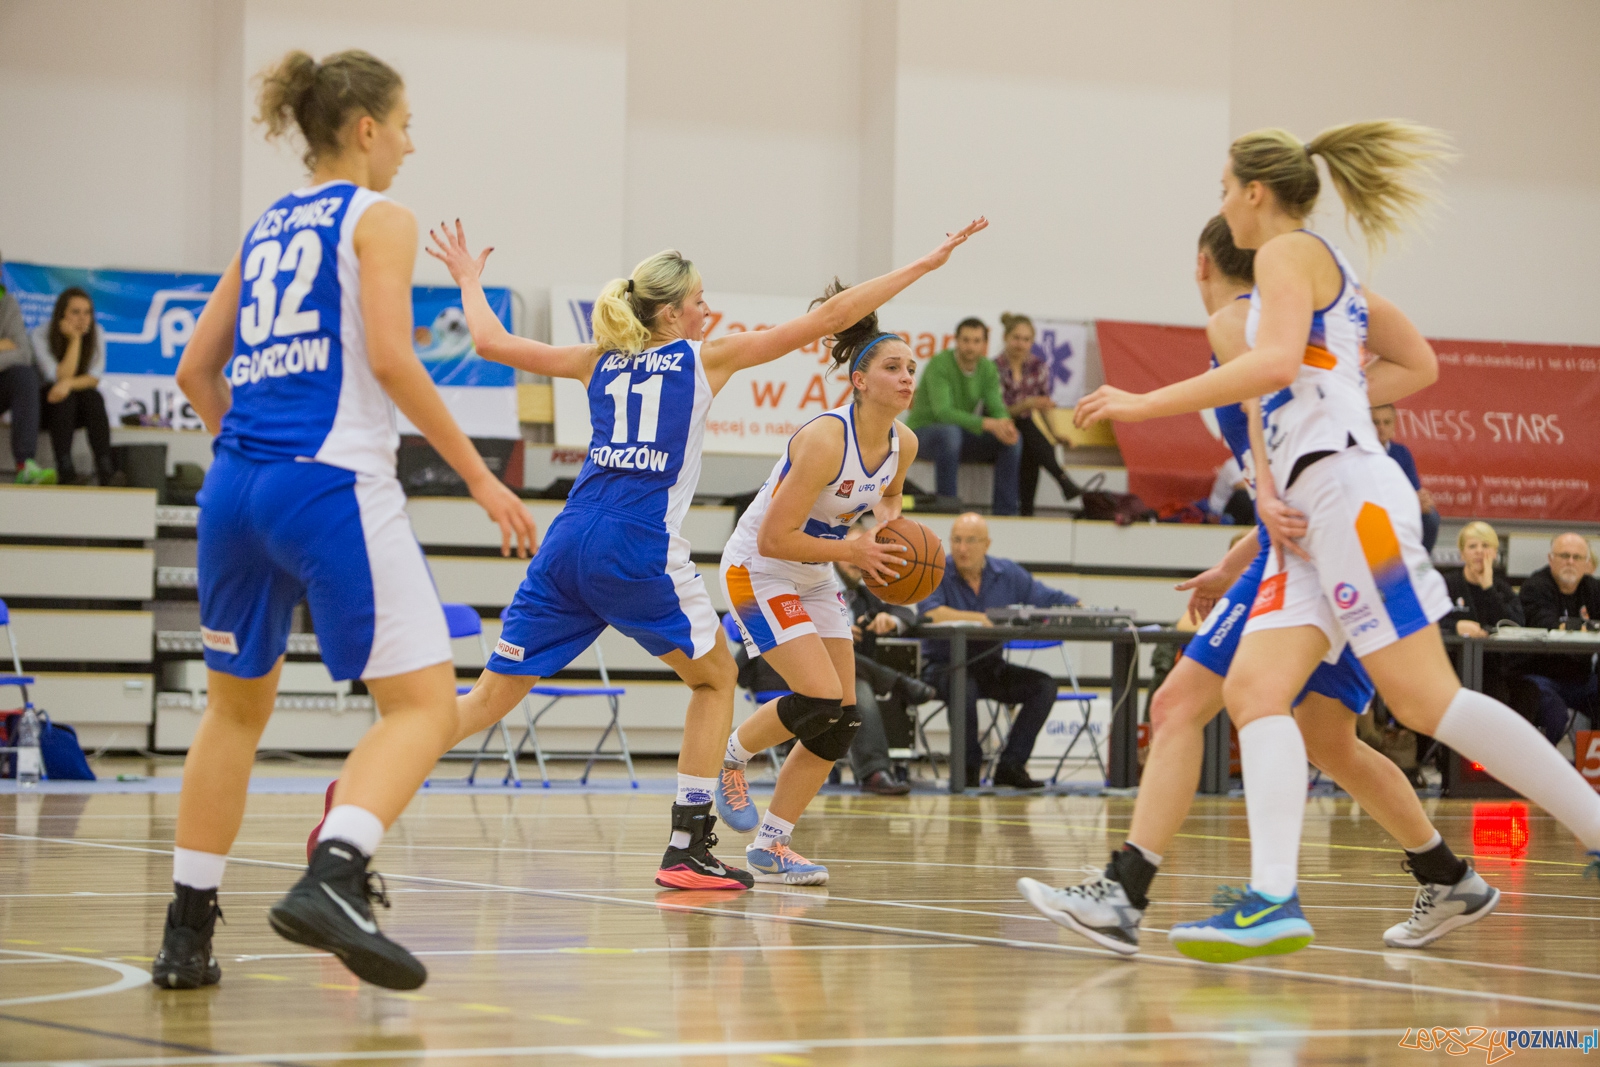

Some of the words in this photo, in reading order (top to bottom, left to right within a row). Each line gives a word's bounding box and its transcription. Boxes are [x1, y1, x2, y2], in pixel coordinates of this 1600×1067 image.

[283, 197, 343, 233] PWSZ
[239, 229, 322, 346] 32
[231, 337, 331, 387] GORZÓW
[633, 352, 684, 373] PWSZ
[605, 372, 663, 443] 11
[705, 417, 744, 438] ięcej
[1394, 408, 1476, 442] TNESS
[1483, 411, 1565, 445] STARS
[590, 445, 669, 473] GORZÓW
